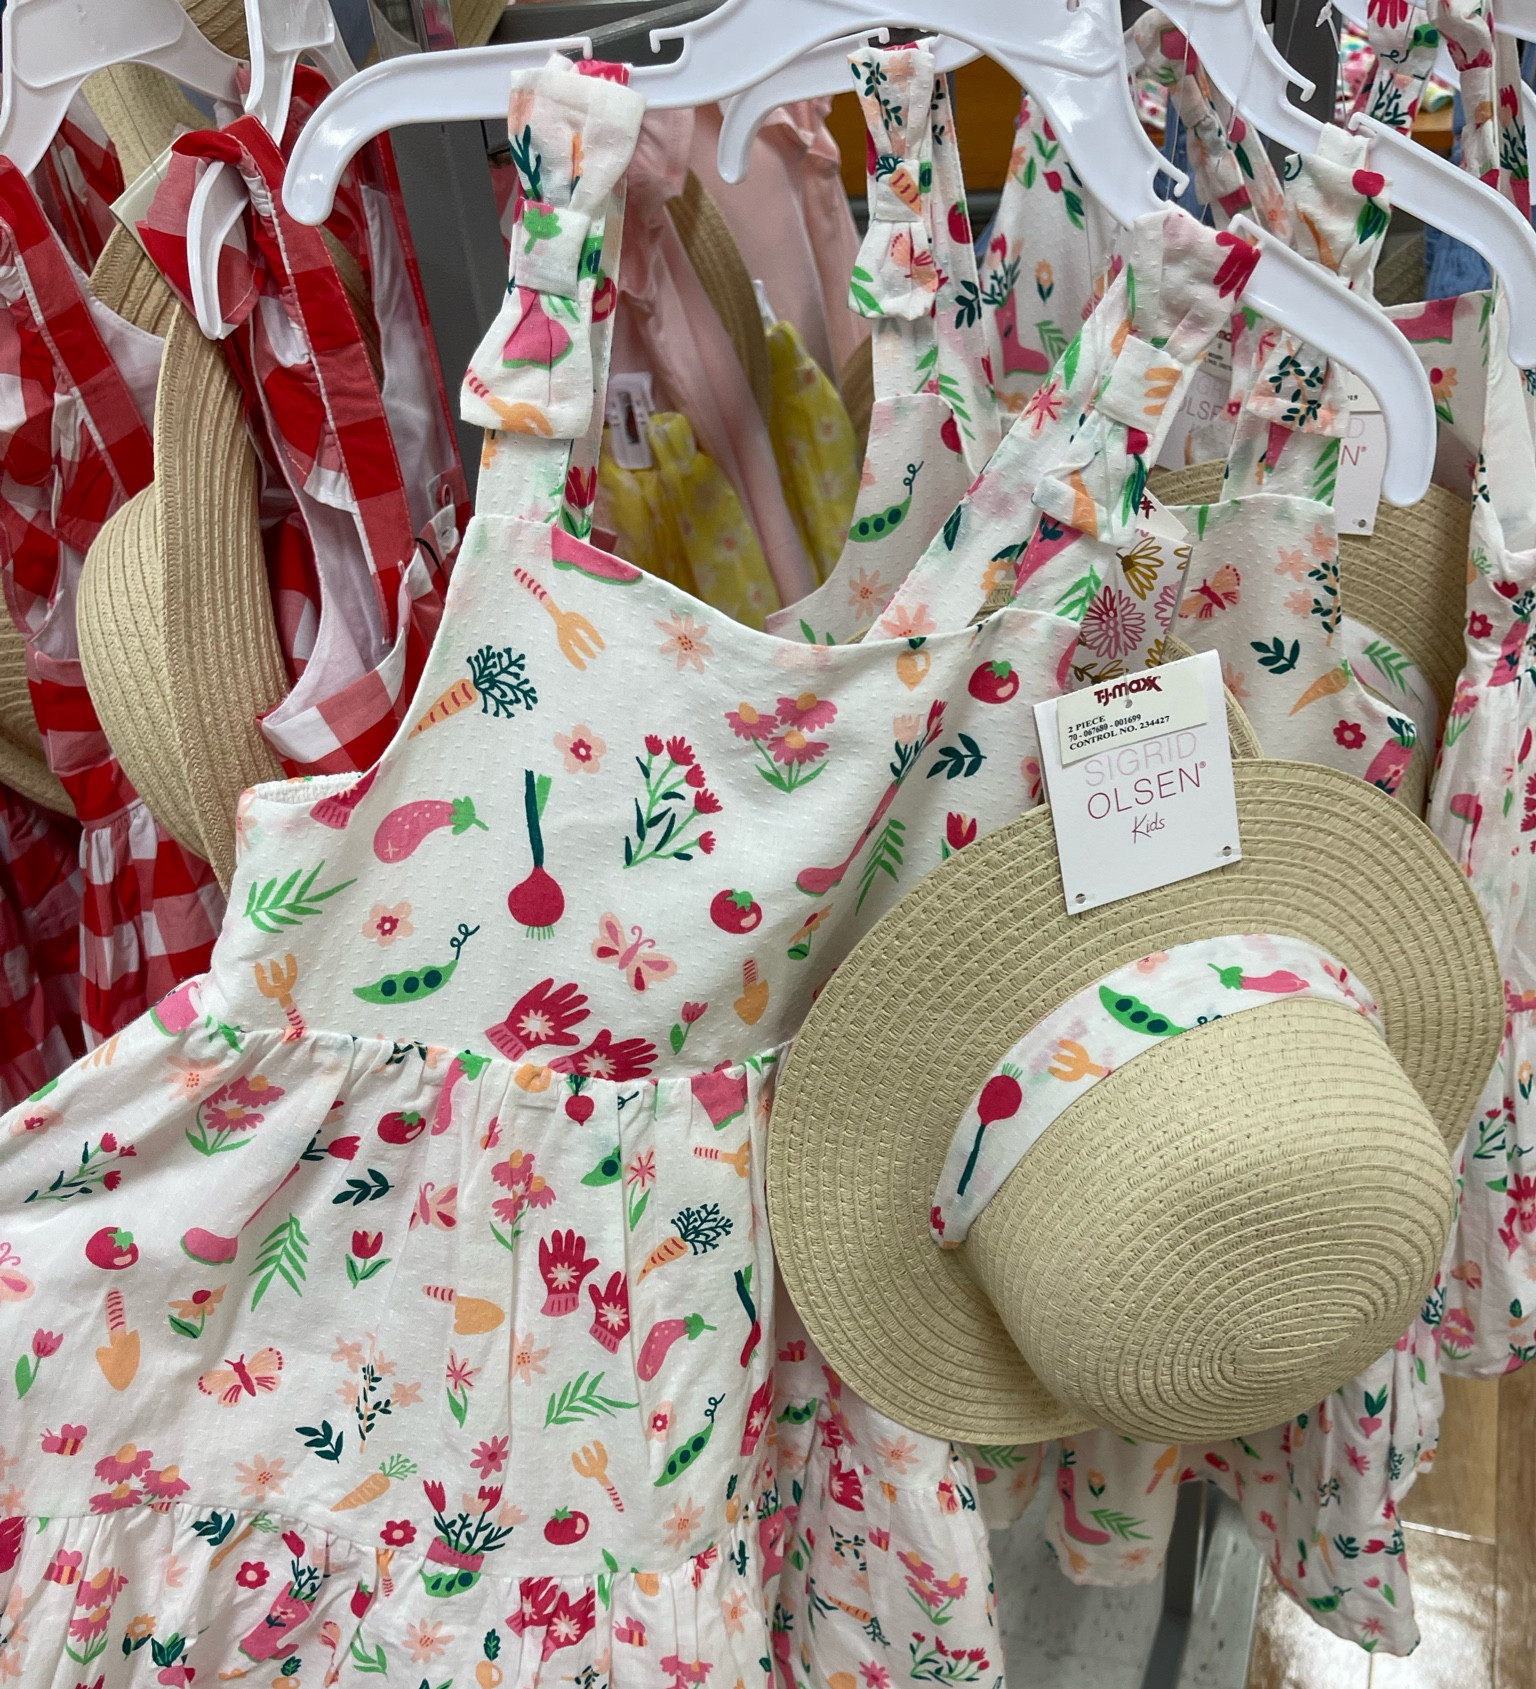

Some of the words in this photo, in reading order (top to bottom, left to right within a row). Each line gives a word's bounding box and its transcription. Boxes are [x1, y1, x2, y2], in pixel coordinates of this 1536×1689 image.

[1068, 733, 1078, 742] 70
[1083, 723, 1108, 737] 067680
[1114, 714, 1141, 727] 001699
[1069, 730, 1117, 750] CONTROL
[1120, 725, 1137, 734] NO.
[1140, 715, 1170, 729] 234427
[1076, 715, 1106, 731] PIECE
[1084, 732, 1197, 786] SIGRID
[1131, 812, 1166, 844] Kids
